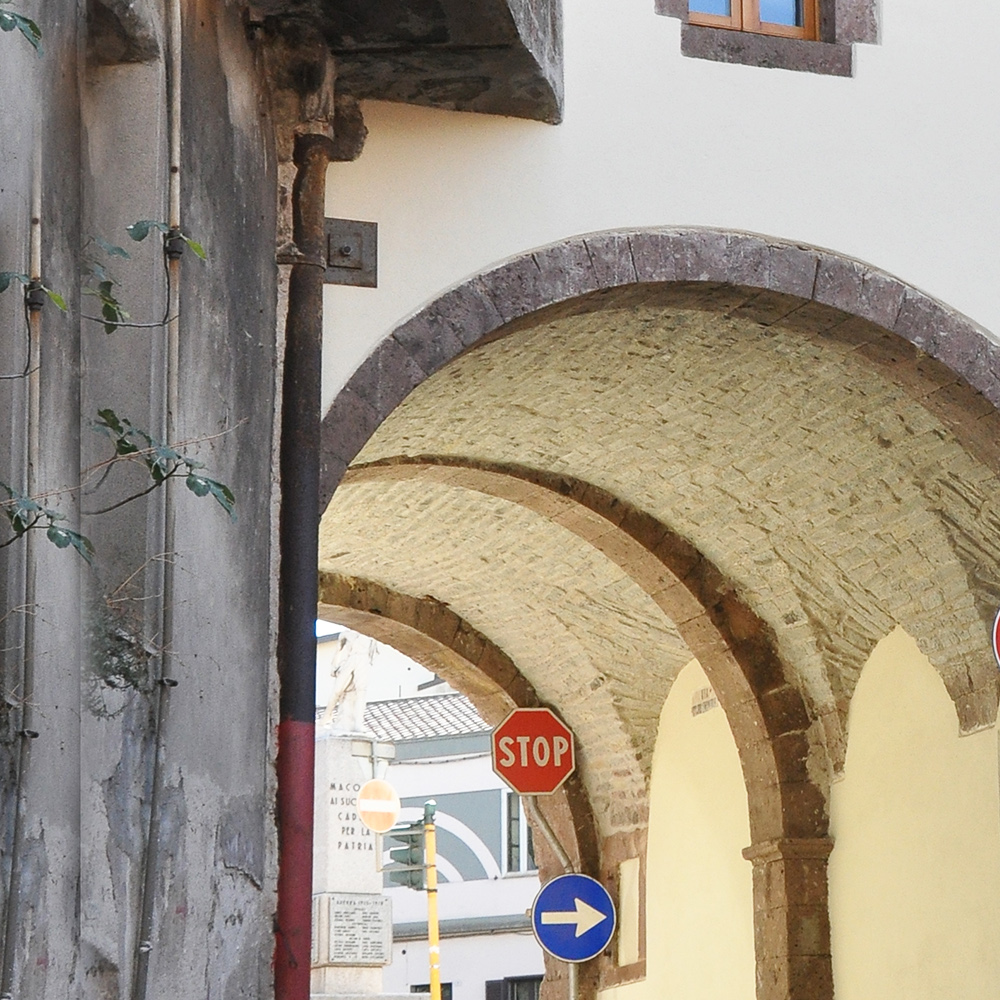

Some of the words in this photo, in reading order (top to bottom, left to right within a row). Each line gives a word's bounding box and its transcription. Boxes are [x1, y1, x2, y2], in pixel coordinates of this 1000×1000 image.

[498, 736, 569, 768] STOP
[329, 782, 361, 792] MACO
[338, 812, 361, 821] CAD
[341, 826, 355, 835] PER
[361, 827, 371, 836] LA
[337, 841, 373, 851] PATRIA
